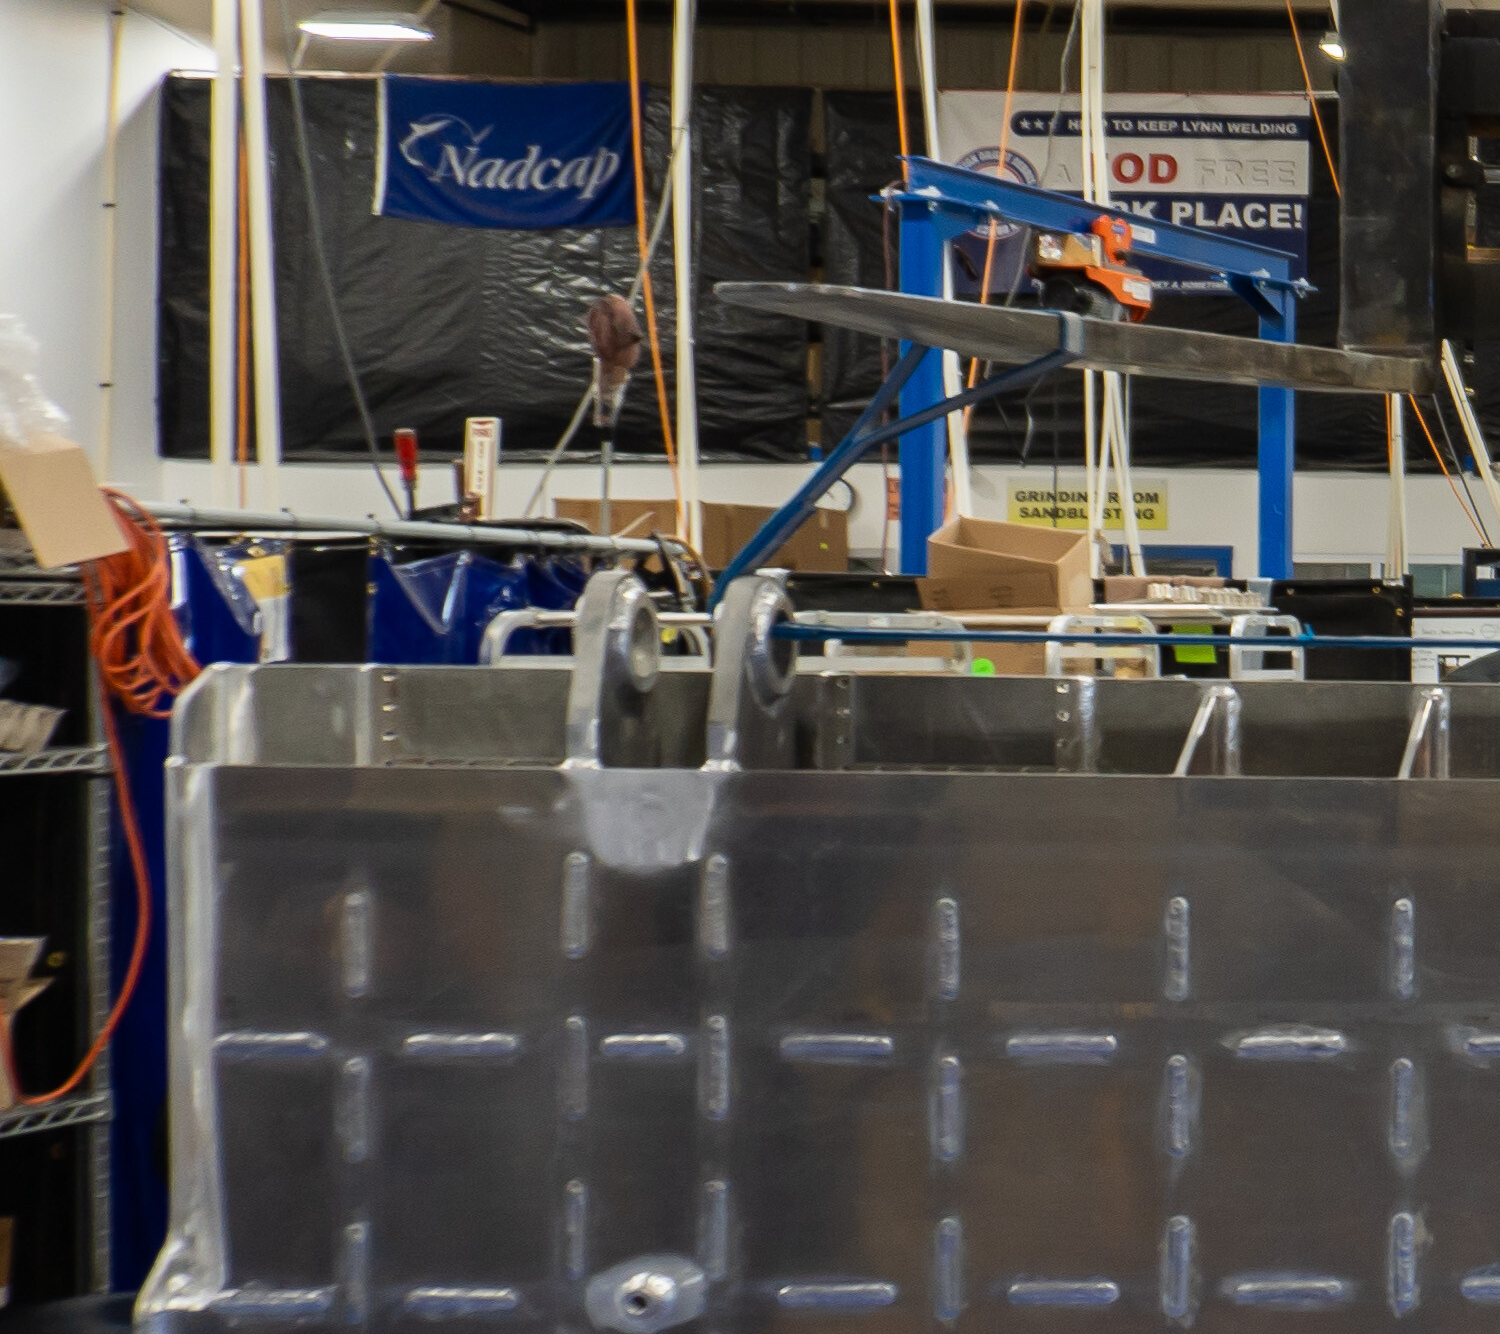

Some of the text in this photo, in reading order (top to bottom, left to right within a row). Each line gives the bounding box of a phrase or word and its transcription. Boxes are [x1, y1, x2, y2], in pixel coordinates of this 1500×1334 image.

[1112, 119, 1133, 131] TO
[1137, 120, 1178, 133] KEEP
[1182, 121, 1223, 134] LYNN
[1227, 122, 1299, 135] WELDING
[427, 144, 621, 201] Nadcap
[1194, 156, 1297, 187] FREE
[1171, 200, 1304, 230] PLACE!
[1015, 490, 1160, 504] GRINDIN ROM
[1019, 506, 1155, 521] SANDBLSTNG
